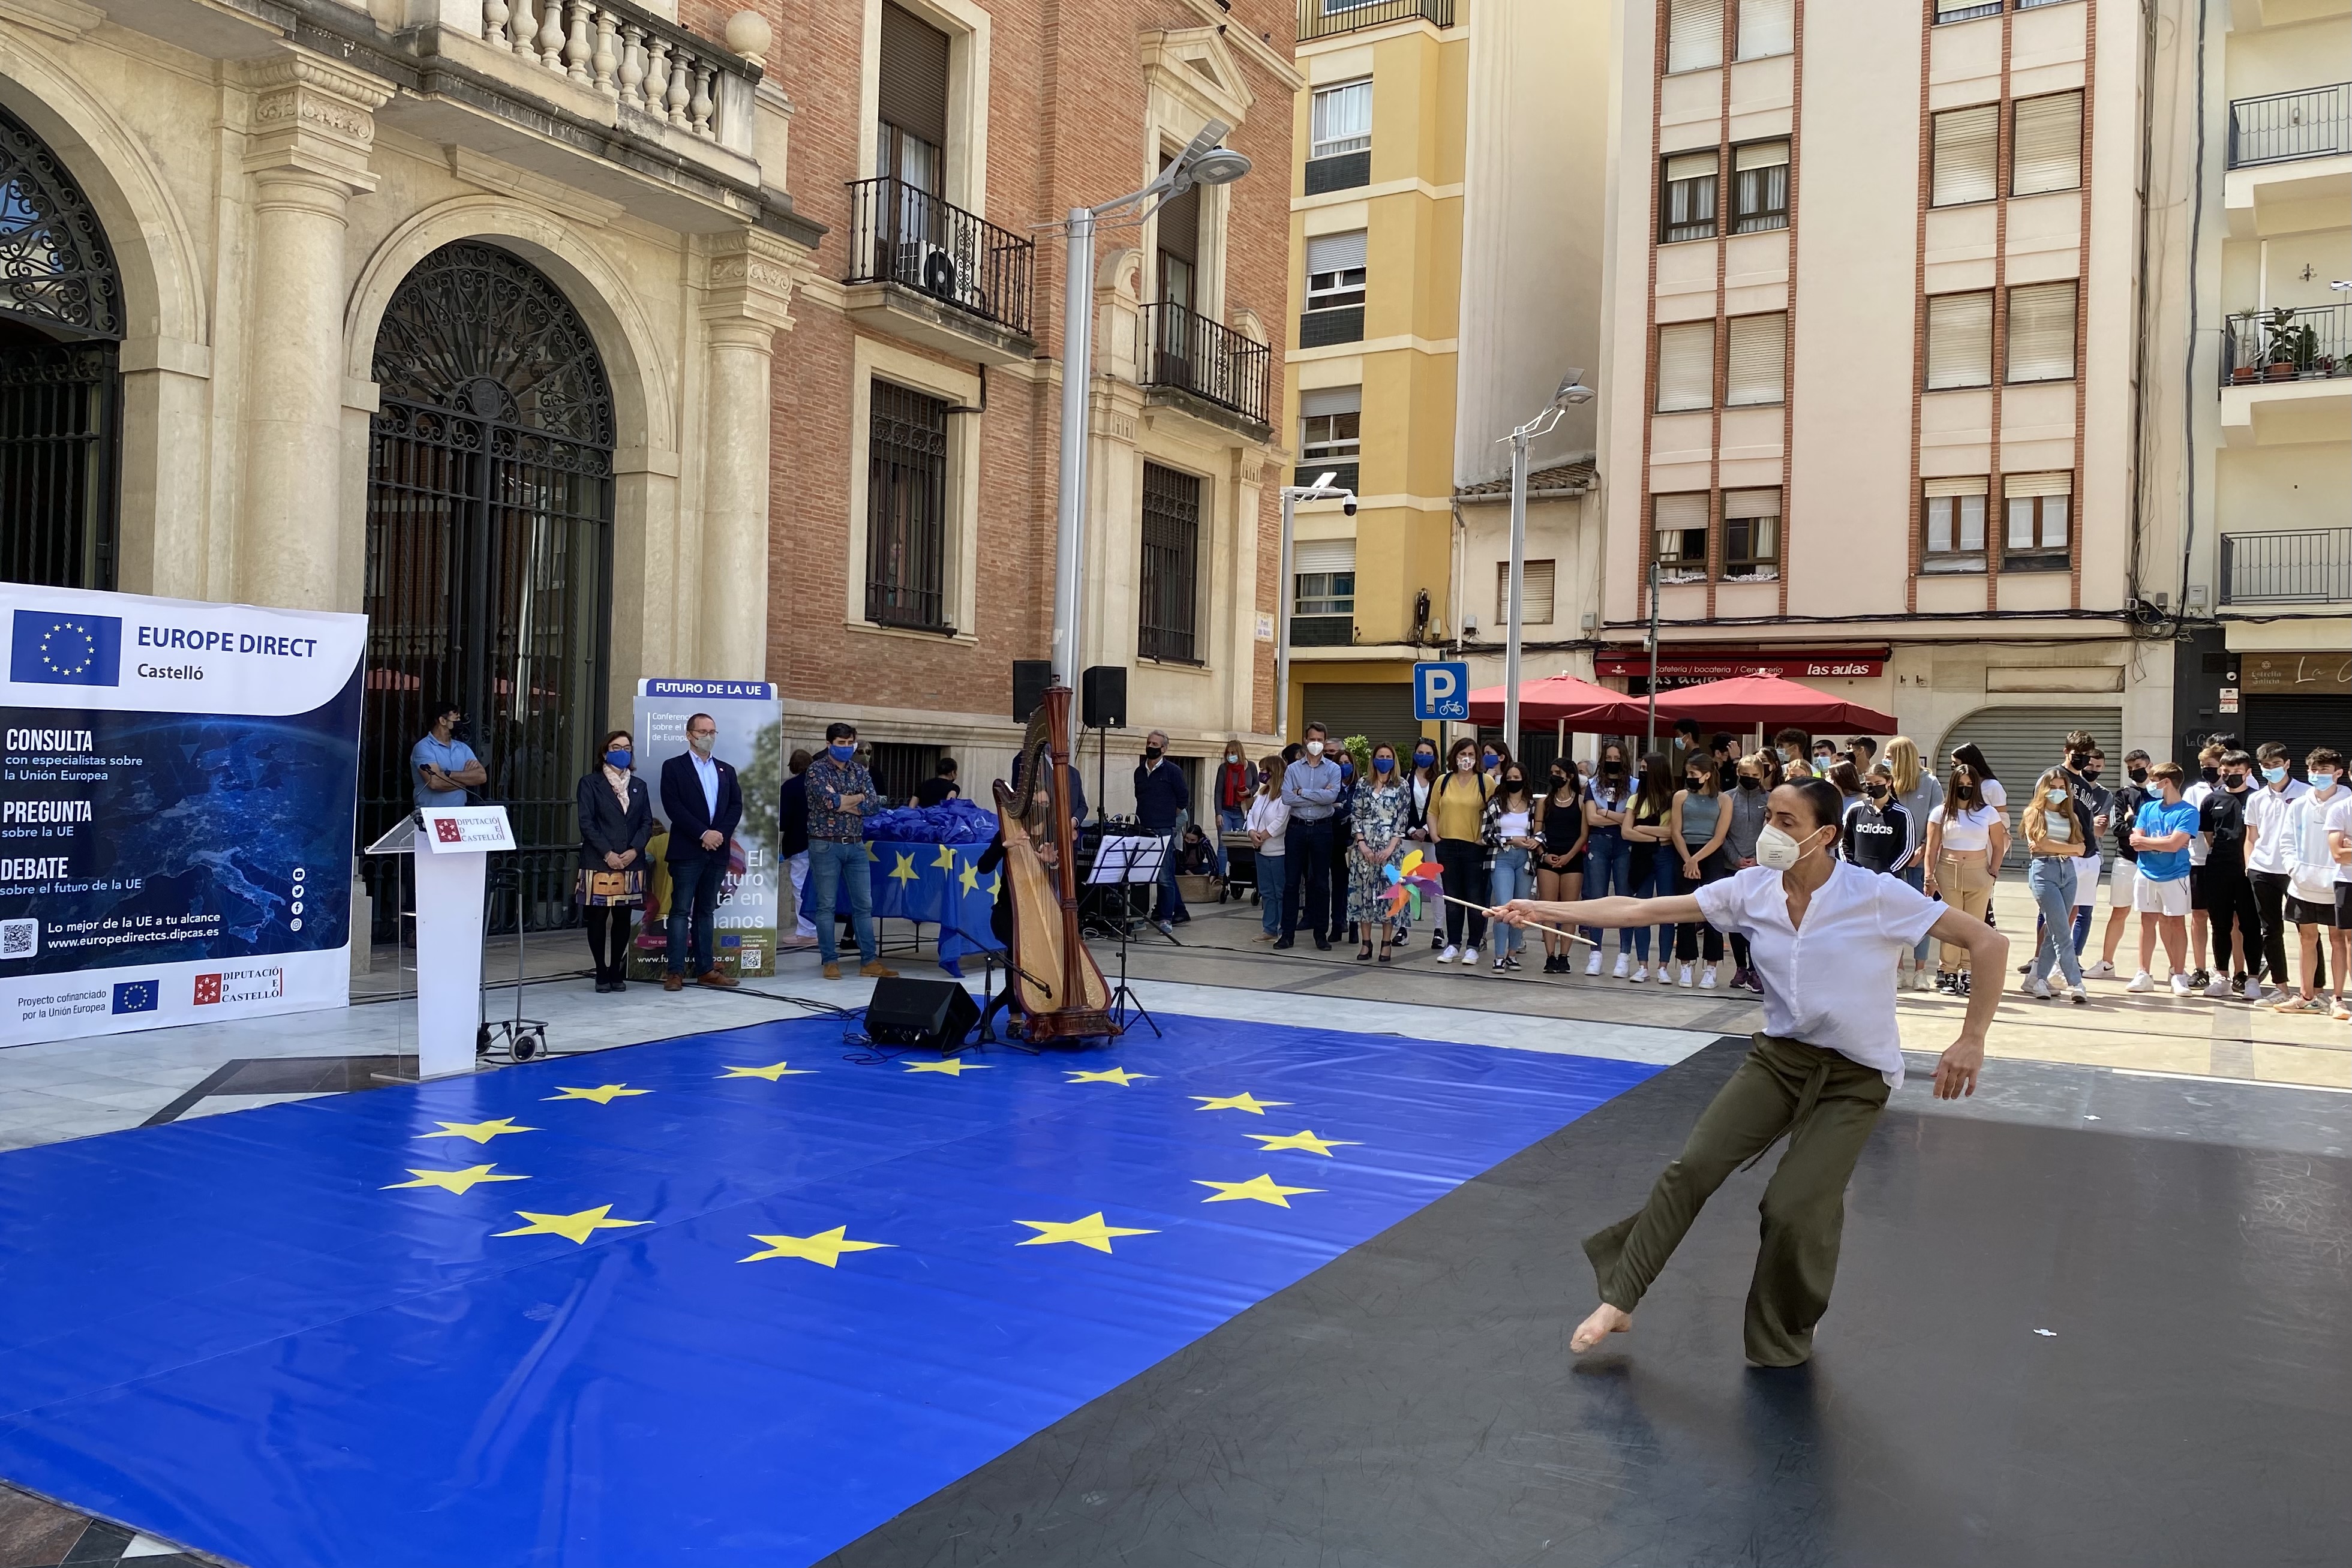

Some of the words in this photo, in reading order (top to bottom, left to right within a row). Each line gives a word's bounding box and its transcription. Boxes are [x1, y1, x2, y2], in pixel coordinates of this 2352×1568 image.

[138, 626, 234, 652] EUROPE
[240, 634, 317, 657] DIRECT
[137, 663, 203, 680] Castelló
[1807, 663, 1829, 675] las
[1831, 663, 1870, 675] aulas
[656, 682, 703, 693] FUTURO
[707, 684, 723, 694] DE
[728, 684, 743, 695] LA
[746, 686, 761, 695] UE
[1425, 669, 1456, 714] P
[6, 728, 93, 752] CONSULTA
[5, 756, 28, 765] con
[32, 755, 106, 767] especialistas
[109, 755, 143, 765] sobre
[5, 769, 15, 780] la
[20, 770, 56, 780] Unión
[61, 770, 109, 783] Europea
[3, 801, 92, 823] PREGUNTA
[456, 816, 498, 825] DIPUTACIÓ
[1856, 822, 1893, 834] adidas
[2, 827, 37, 837] sobre
[42, 826, 52, 836] la
[57, 826, 74, 836] UE
[461, 833, 503, 842] CASTELLÓ
[747, 849, 763, 867] El
[1, 857, 69, 881] DEBATE
[0, 884, 35, 895] sobre
[40, 883, 50, 893] el
[54, 882, 88, 893] futuro
[92, 880, 107, 890] de
[112, 879, 121, 890] la
[126, 879, 142, 888] UE
[740, 893, 763, 906] en
[48, 923, 62, 933] Lo
[67, 920, 99, 933] mejor
[103, 918, 118, 929] de
[122, 917, 132, 928] la
[136, 916, 152, 927] UE
[166, 915, 178, 925] tu
[181, 913, 220, 924] alcance
[48, 929, 219, 948] www.europedirectcs.dipcas.es
[223, 966, 280, 980] DIPUTACIÓ
[18, 995, 55, 1008] Proyecto
[56, 989, 106, 1003] cofinanciado
[222, 988, 280, 1003] CASTELLÓ
[22, 1011, 37, 1022] por
[38, 1009, 46, 1018] la
[49, 1006, 71, 1017] Unión
[73, 1003, 106, 1014] Europea
